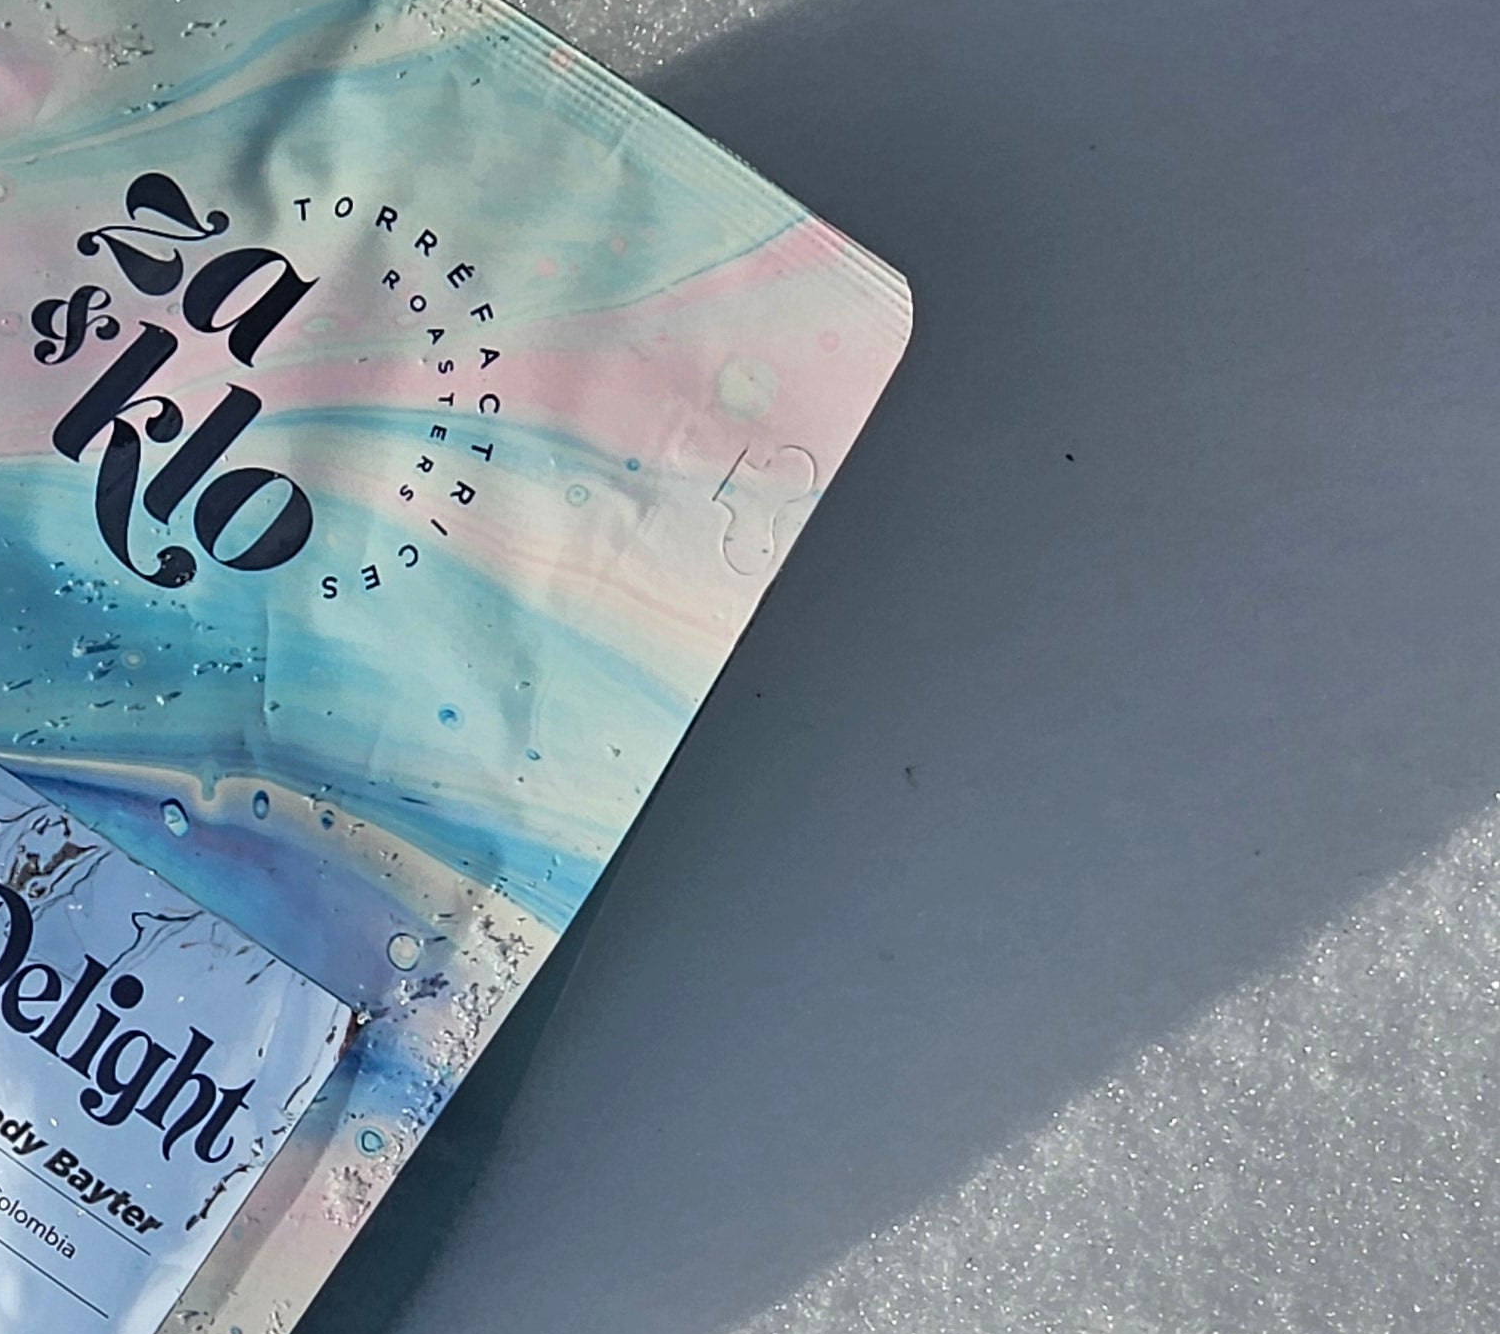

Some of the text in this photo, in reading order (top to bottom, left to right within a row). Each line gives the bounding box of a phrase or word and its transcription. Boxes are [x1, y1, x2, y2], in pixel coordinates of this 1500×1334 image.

[77, 172, 320, 367] za
[52, 321, 313, 588] klo
[383, 269, 454, 501] ROASTERS
[44, 1148, 164, 1235] Bayter
